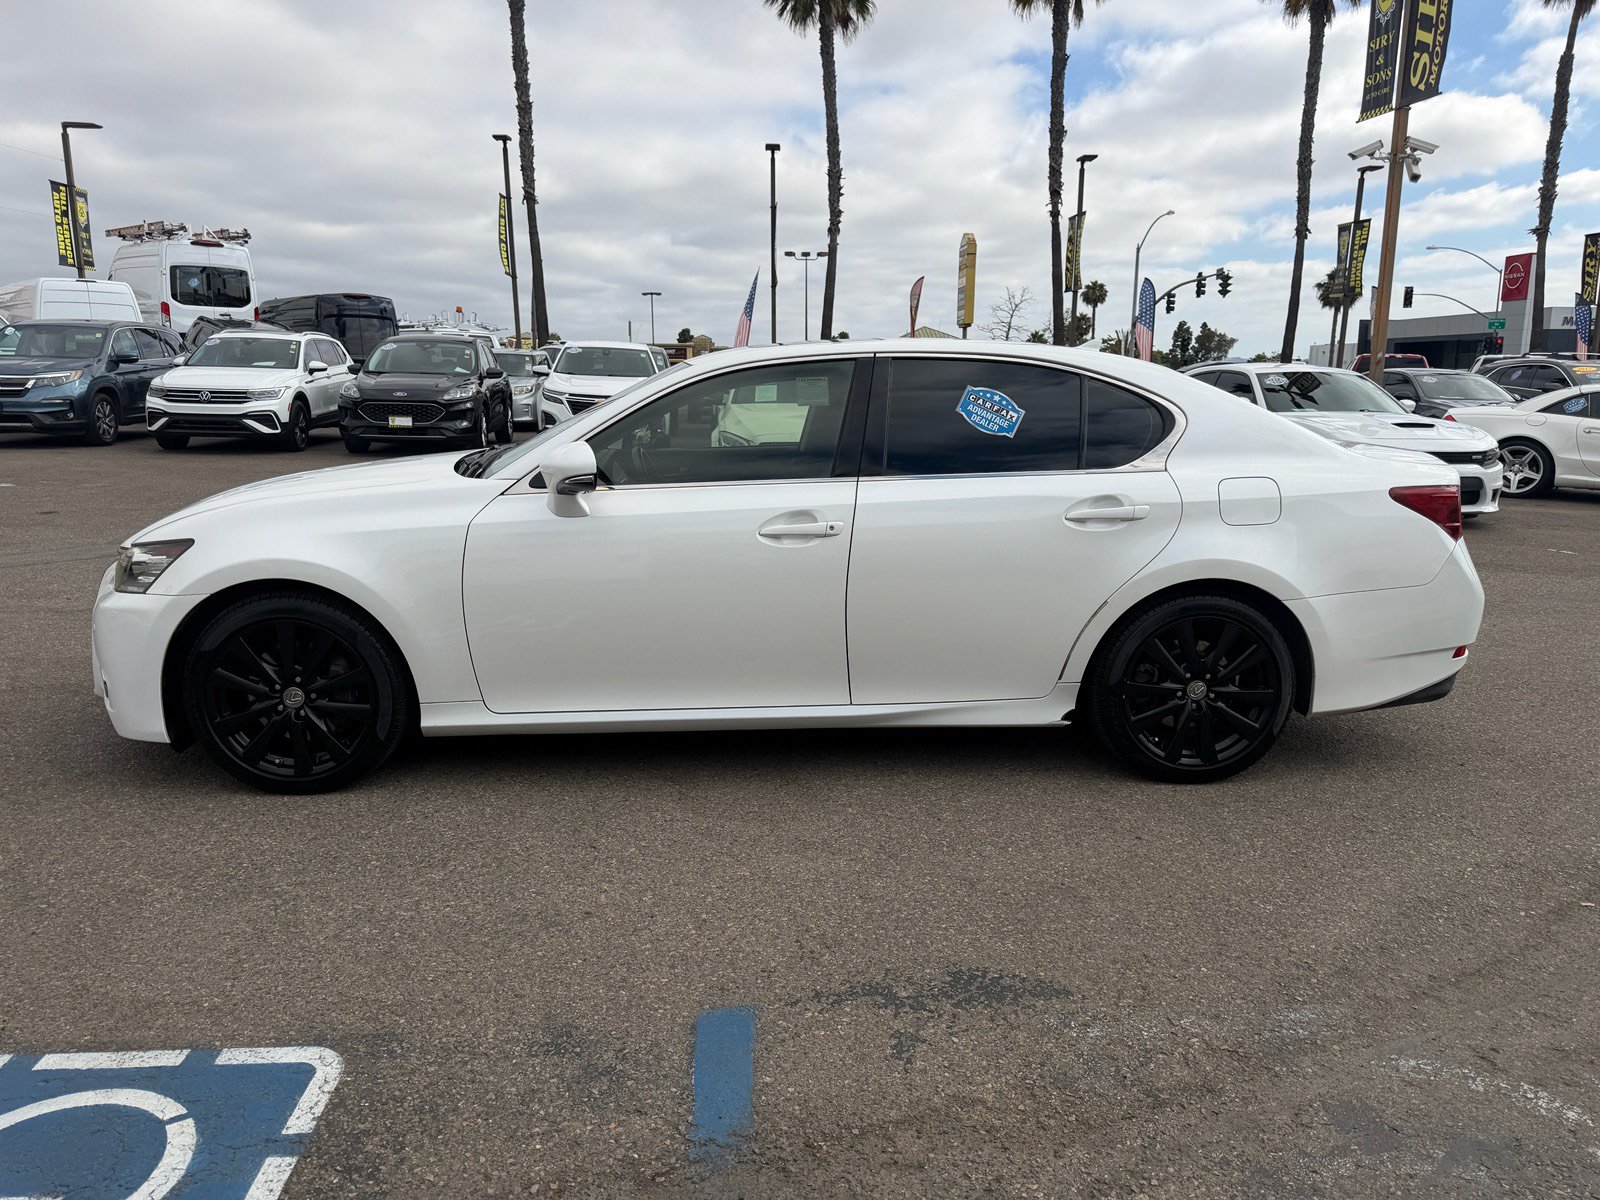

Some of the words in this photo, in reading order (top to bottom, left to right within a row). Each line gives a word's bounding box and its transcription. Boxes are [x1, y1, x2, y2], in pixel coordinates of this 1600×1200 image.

[1369, 30, 1395, 53] SIRY
[1376, 53, 1385, 66] &
[1365, 67, 1392, 88] SONS
[52, 191, 62, 224] AUTO
[59, 185, 67, 212] FULL
[56, 225, 66, 256] CARE
[62, 216, 75, 265] SERVICE
[1352, 229, 1362, 258] AUTO
[1360, 222, 1370, 246] FULL
[1349, 260, 1357, 287] CARE
[1355, 249, 1365, 293] SERVICE
[1583, 238, 1597, 302] SIRY
[967, 404, 1010, 428] ADVANTAGE
[968, 393, 1017, 422] CARFAX
[971, 413, 999, 432] DEALER
